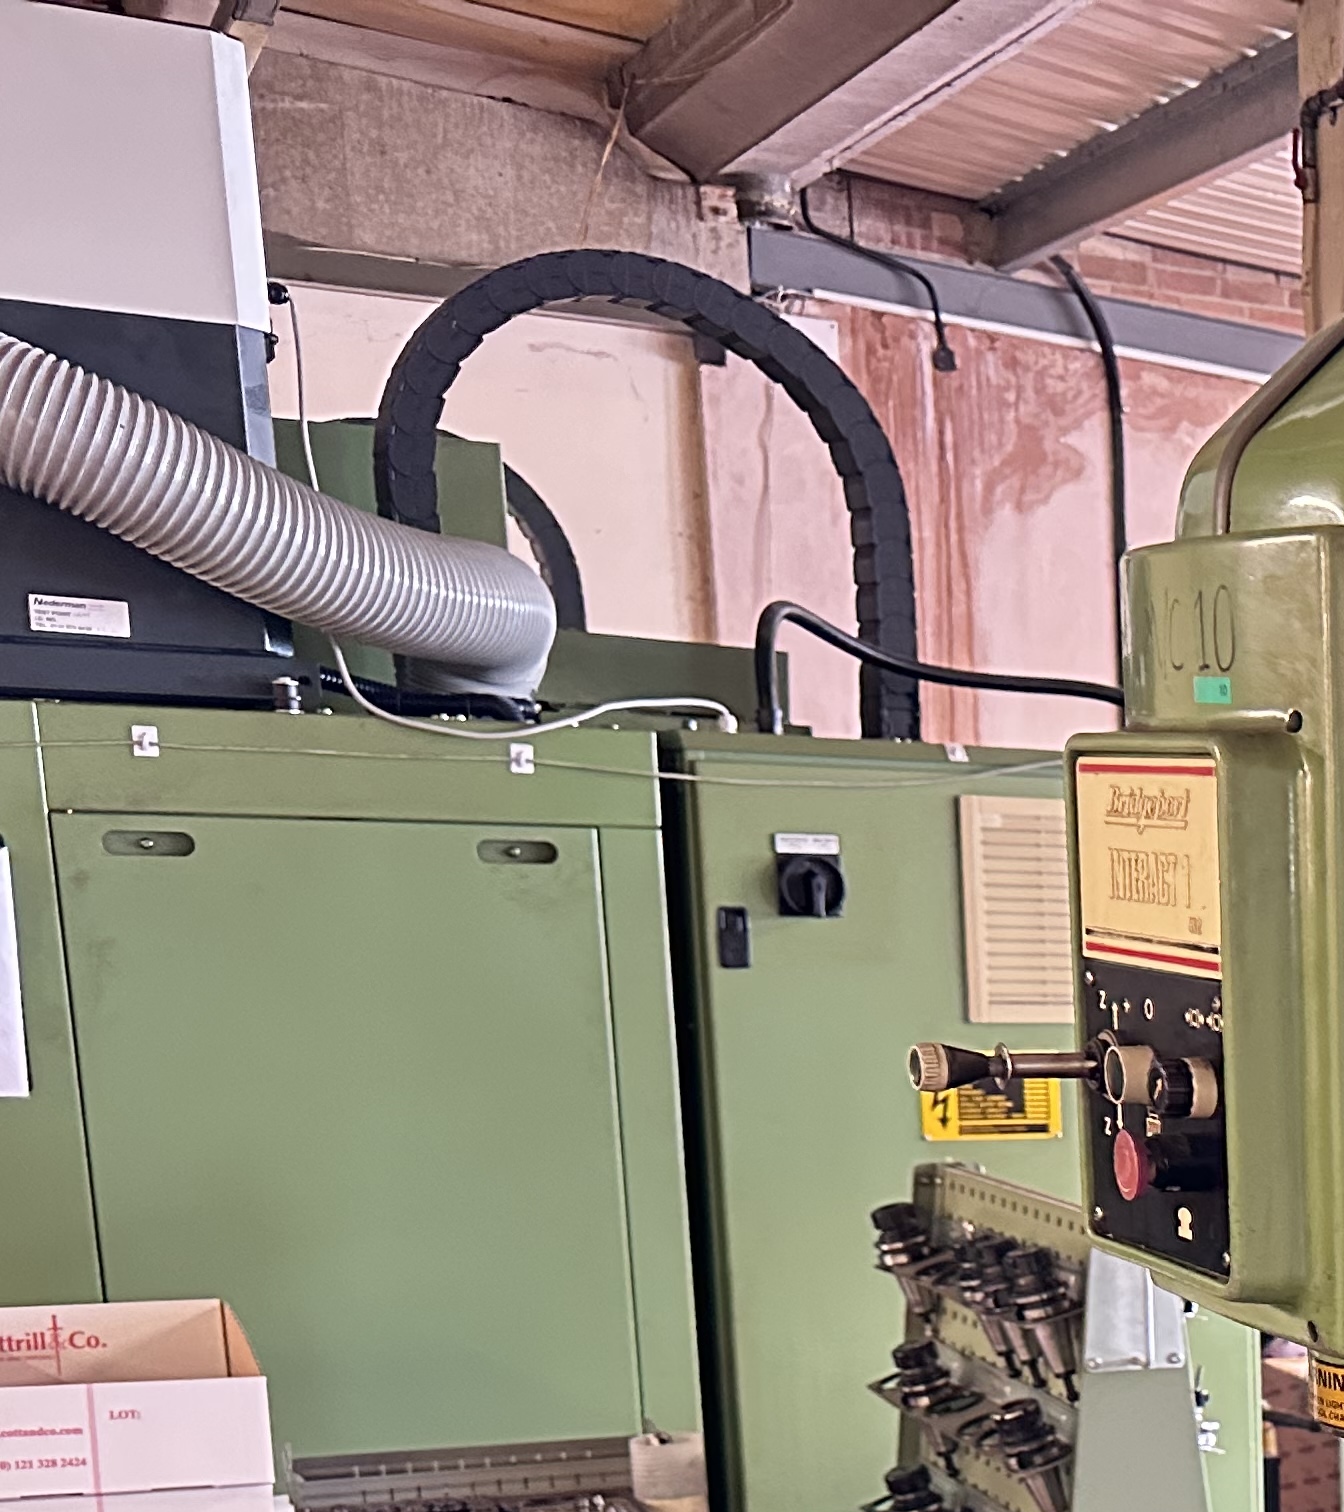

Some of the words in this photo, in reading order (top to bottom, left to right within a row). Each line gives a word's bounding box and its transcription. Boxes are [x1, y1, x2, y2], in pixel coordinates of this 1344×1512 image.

[1195, 585, 1235, 672] 10
[1107, 785, 1191, 835] Bridgeport
[1108, 847, 1178, 907] INTERACT
[69, 1330, 107, 1349] Co.
[15, 1460, 33, 1470] 121
[60, 1457, 87, 1468] 2424
